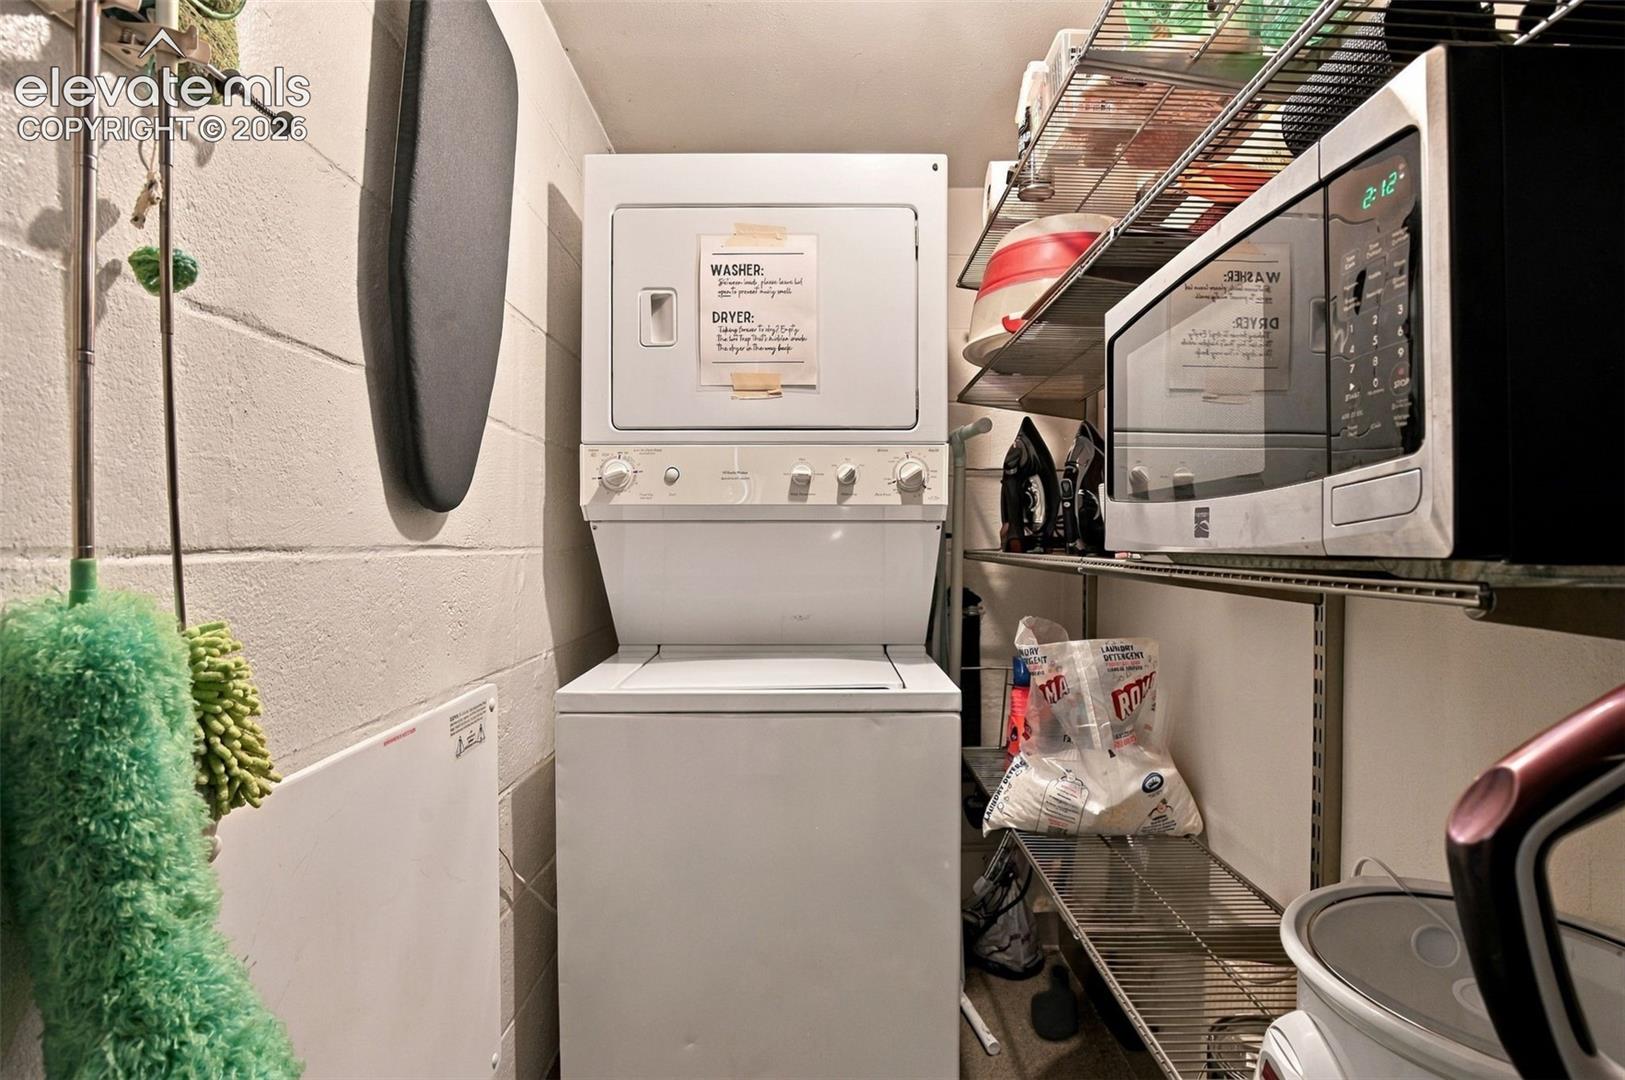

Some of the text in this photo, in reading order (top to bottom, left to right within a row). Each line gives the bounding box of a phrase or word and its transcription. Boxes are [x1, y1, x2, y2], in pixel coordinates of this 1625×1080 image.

[1362, 171, 1397, 209] 2:12
[710, 263, 765, 276] WASHER:
[1397, 304, 1404, 315] 3
[712, 311, 755, 324] DRYER:
[1372, 315, 1378, 325] 2
[1397, 325, 1404, 337] 6
[1372, 335, 1378, 346] 5
[1397, 347, 1404, 358] 9
[1372, 356, 1378, 367] 8
[1349, 364, 1355, 374] 7
[1372, 378, 1379, 388] 0
[1101, 644, 1134, 653] LAUNDRY
[1103, 651, 1145, 662] DETERGENT
[984, 785, 1004, 822] LAUNDRY
